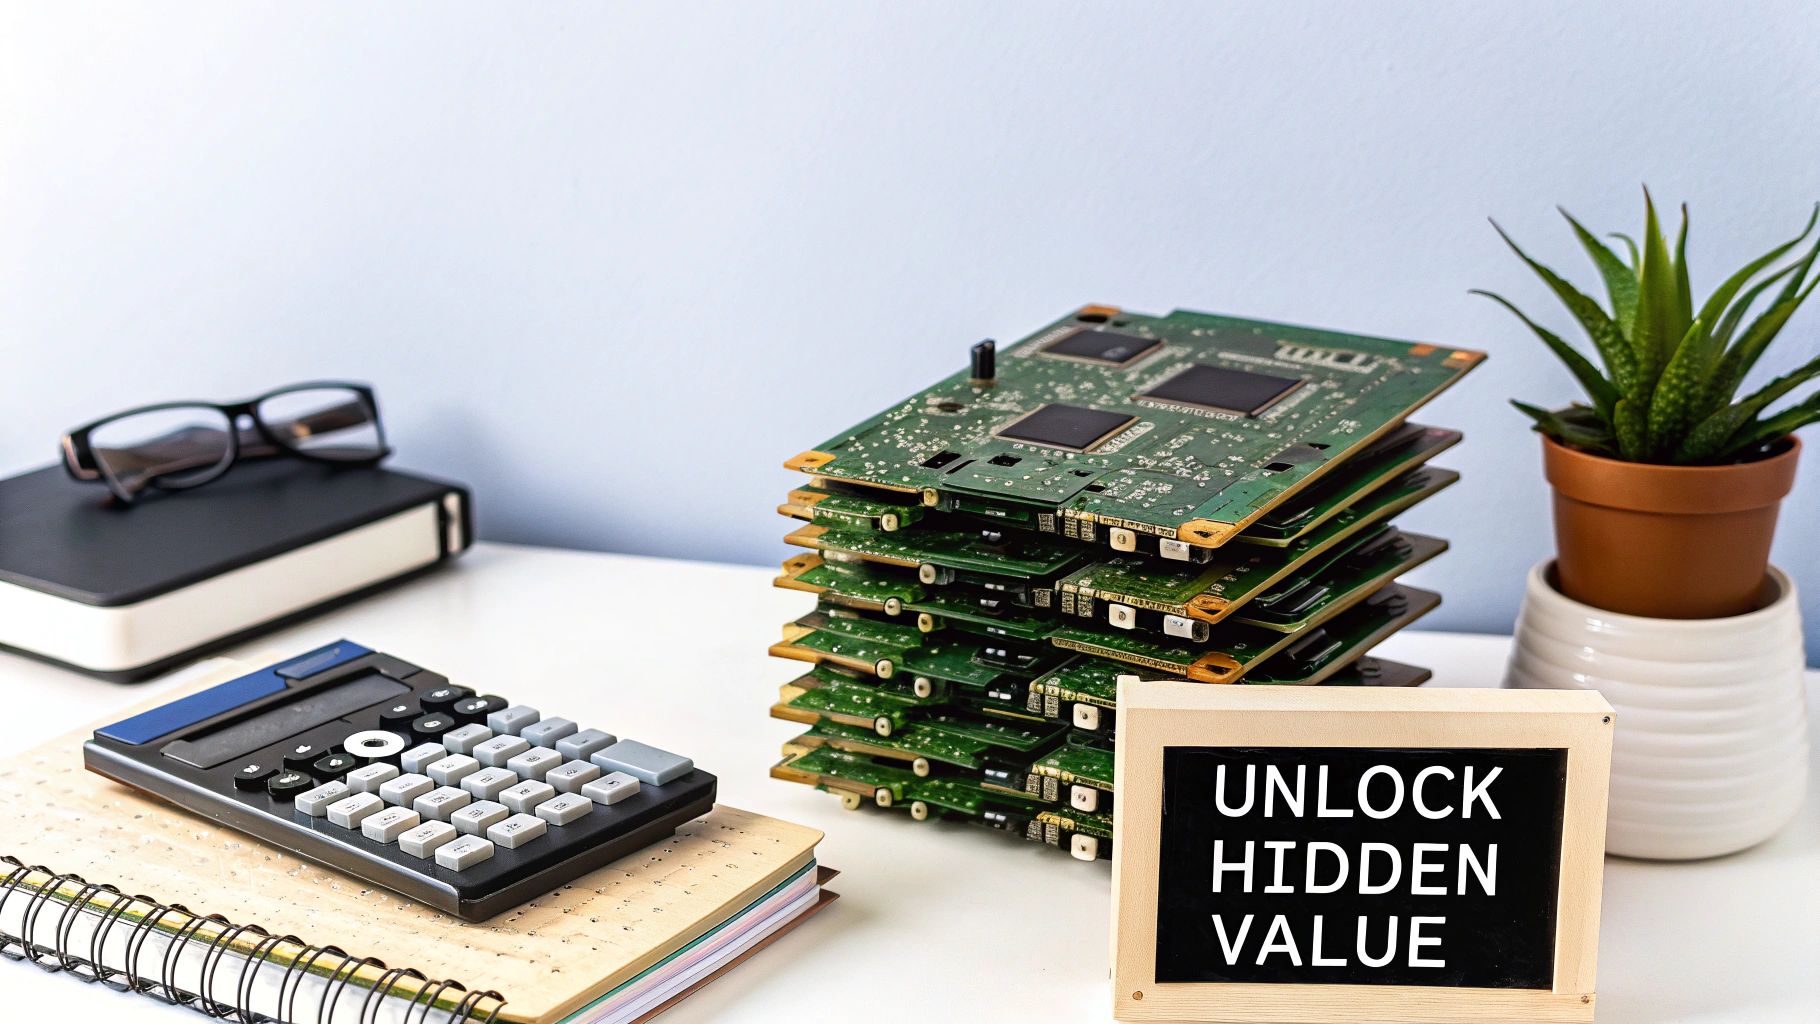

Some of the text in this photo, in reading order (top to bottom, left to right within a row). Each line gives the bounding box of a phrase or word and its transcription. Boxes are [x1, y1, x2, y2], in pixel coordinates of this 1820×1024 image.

[1214, 763, 1504, 820] UNLOCK
[1211, 839, 1498, 897] HIDDEN
[1211, 914, 1447, 968] VALUE
